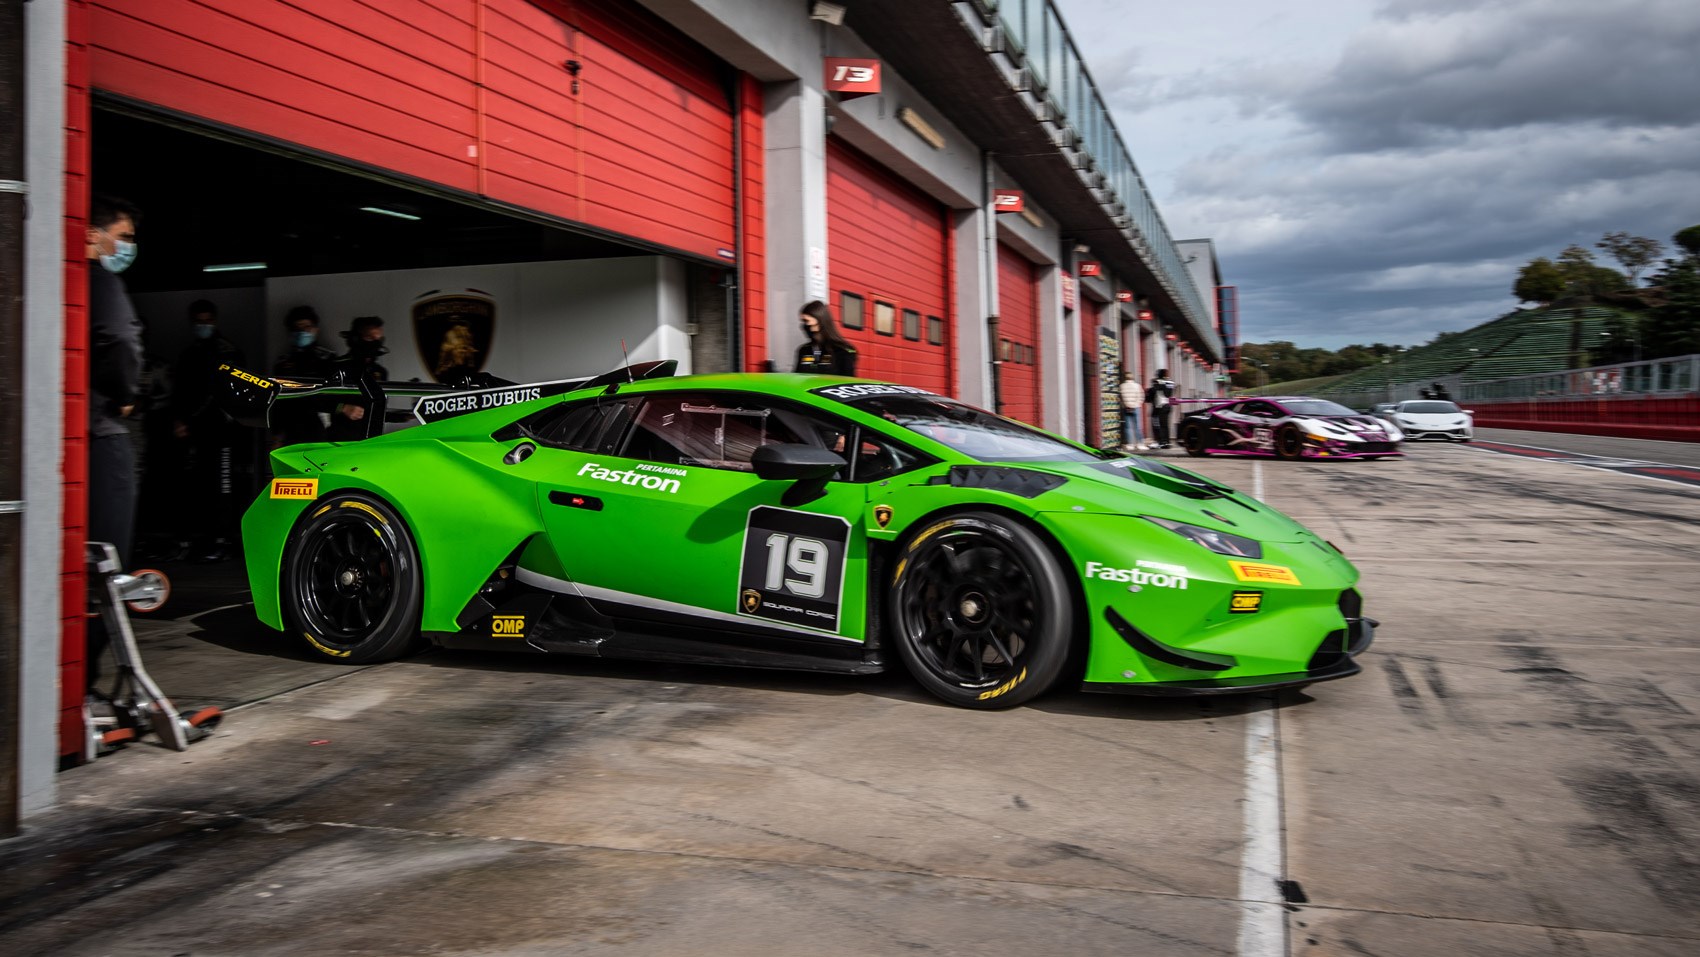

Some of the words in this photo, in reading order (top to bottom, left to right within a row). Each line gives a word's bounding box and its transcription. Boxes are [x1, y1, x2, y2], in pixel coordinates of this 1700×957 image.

[833, 65, 875, 83] 13
[994, 194, 1020, 206] 12
[230, 368, 271, 389] ZERO
[424, 395, 478, 415] ROGER
[481, 387, 541, 408] DUBUIS
[577, 462, 681, 494] Fastron
[635, 463, 688, 477] PERTAMINA
[274, 482, 313, 496] PIRELLI
[765, 533, 829, 599] 19
[1085, 561, 1189, 590] Fastron
[492, 619, 525, 634] OMP
